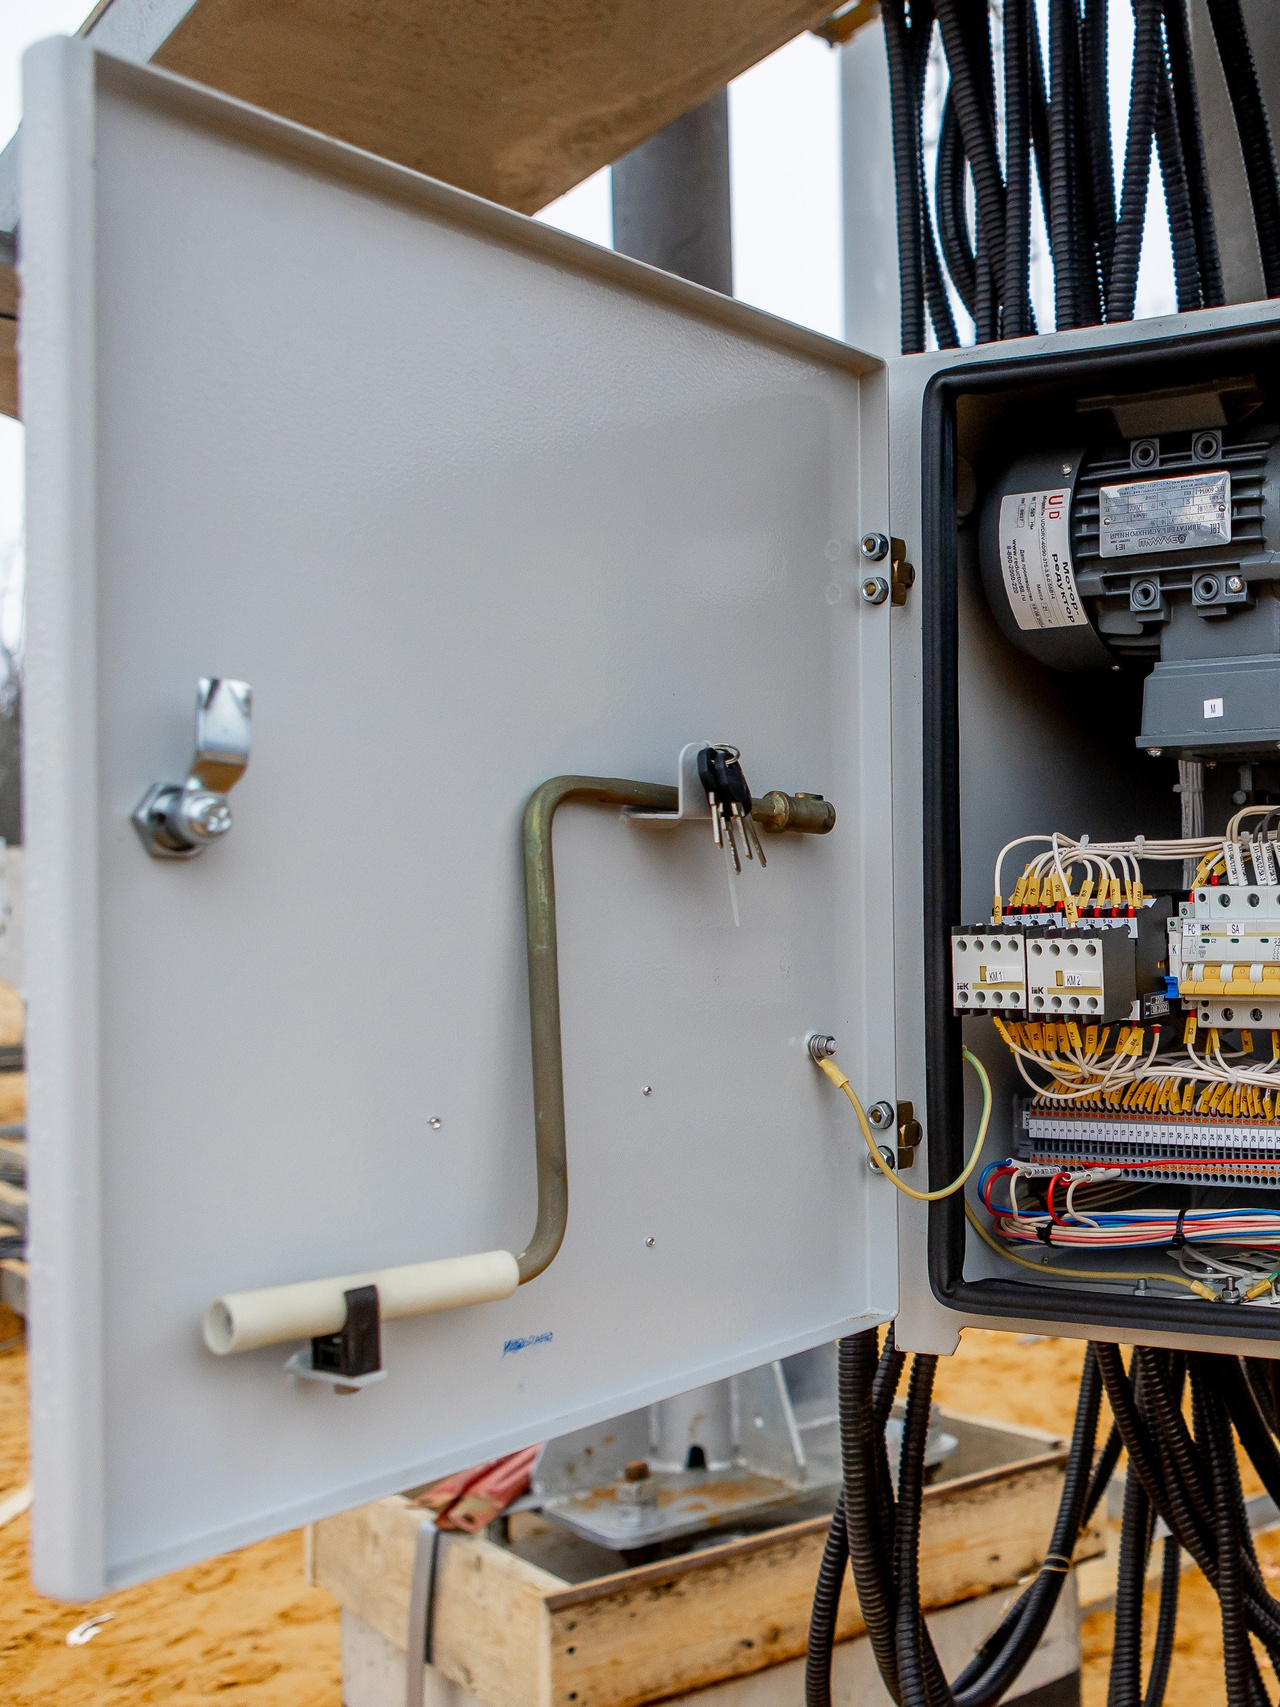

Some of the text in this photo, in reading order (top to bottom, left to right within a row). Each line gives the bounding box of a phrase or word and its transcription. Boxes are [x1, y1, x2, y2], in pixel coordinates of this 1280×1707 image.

[1006, 545, 1019, 594] 8-800-2000-220
[1011, 539, 1027, 601] www.reductor58.ru
[1052, 553, 1075, 623] редуктор
[1062, 561, 1080, 616] Мотор-
[1210, 703, 1216, 714] M
[1188, 925, 1196, 934] FC
[1231, 924, 1239, 934] SA
[1172, 945, 1177, 954] K
[989, 972, 998, 982] KM
[1066, 975, 1076, 985] KM
